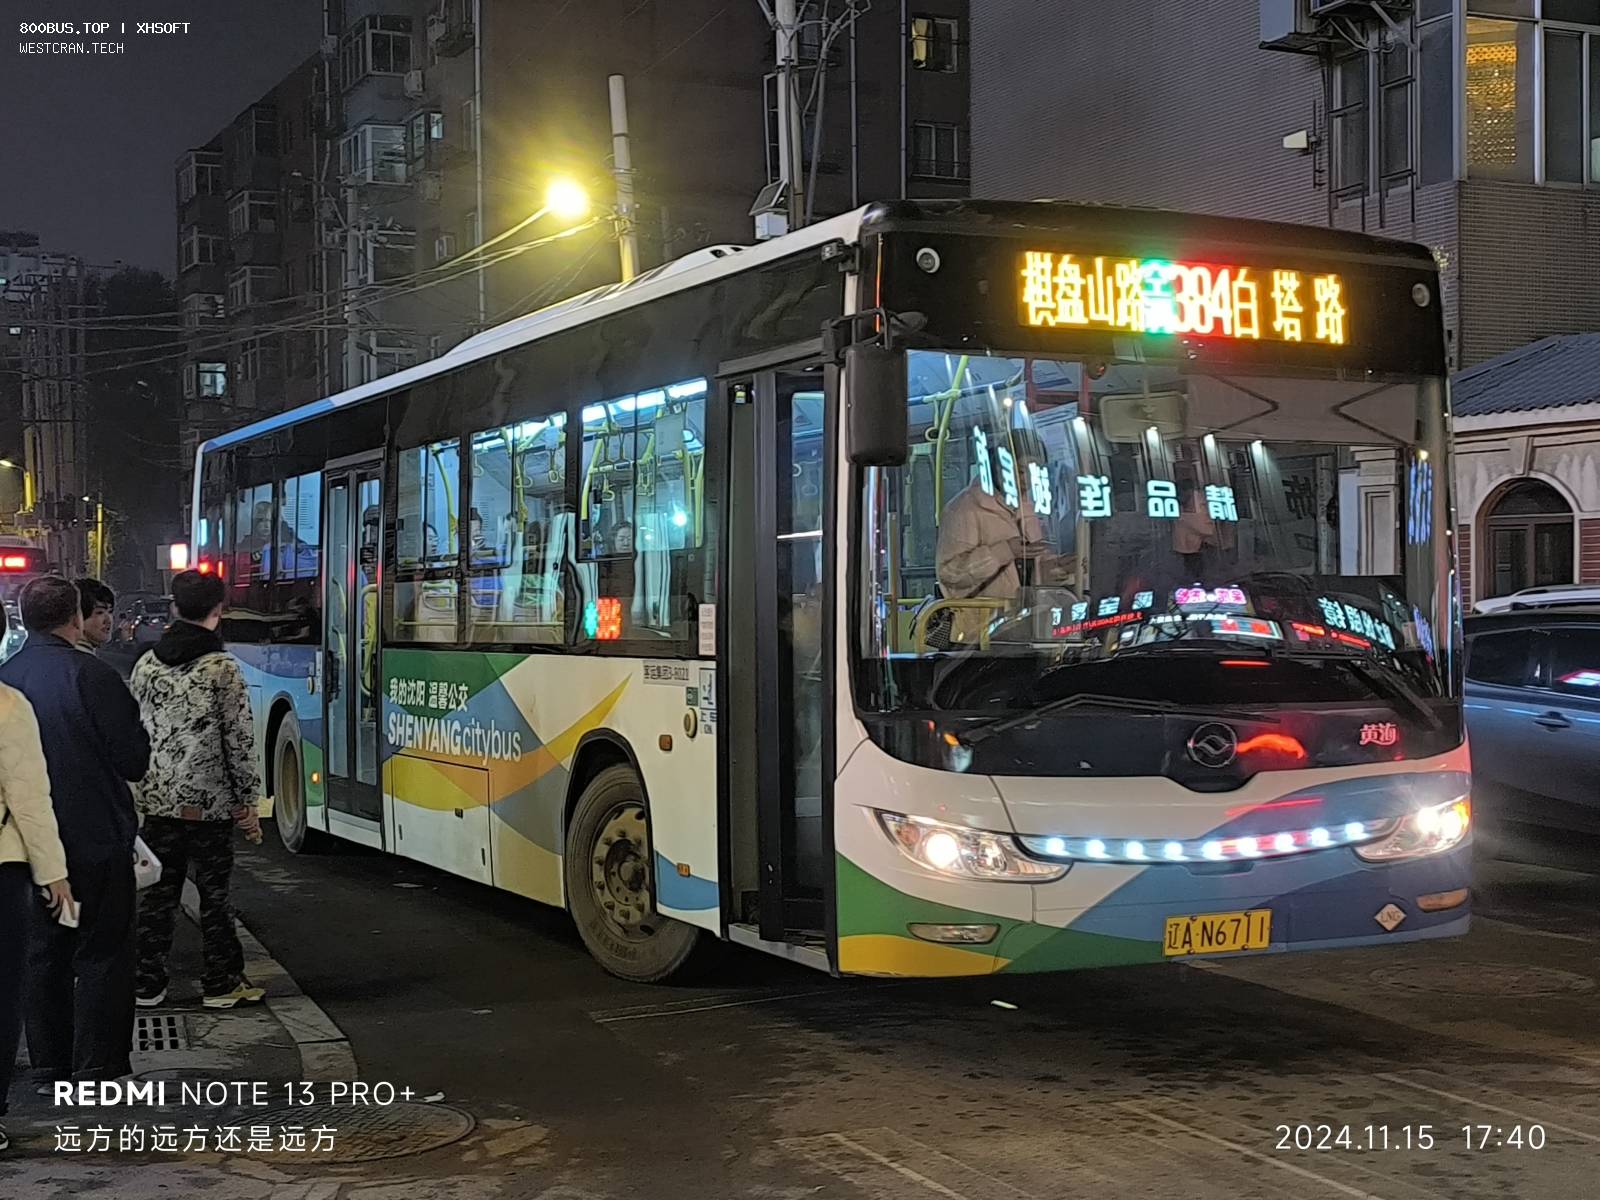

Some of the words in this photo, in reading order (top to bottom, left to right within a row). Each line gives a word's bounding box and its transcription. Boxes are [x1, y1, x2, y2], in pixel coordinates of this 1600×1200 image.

[1021, 250, 1143, 331] 棋盘山路
[1171, 263, 1232, 336] 384
[389, 677, 426, 706] 我的沈阳
[428, 681, 469, 712] 温馨公交
[387, 711, 462, 756] SHENYANG
[462, 717, 522, 766] citybus
